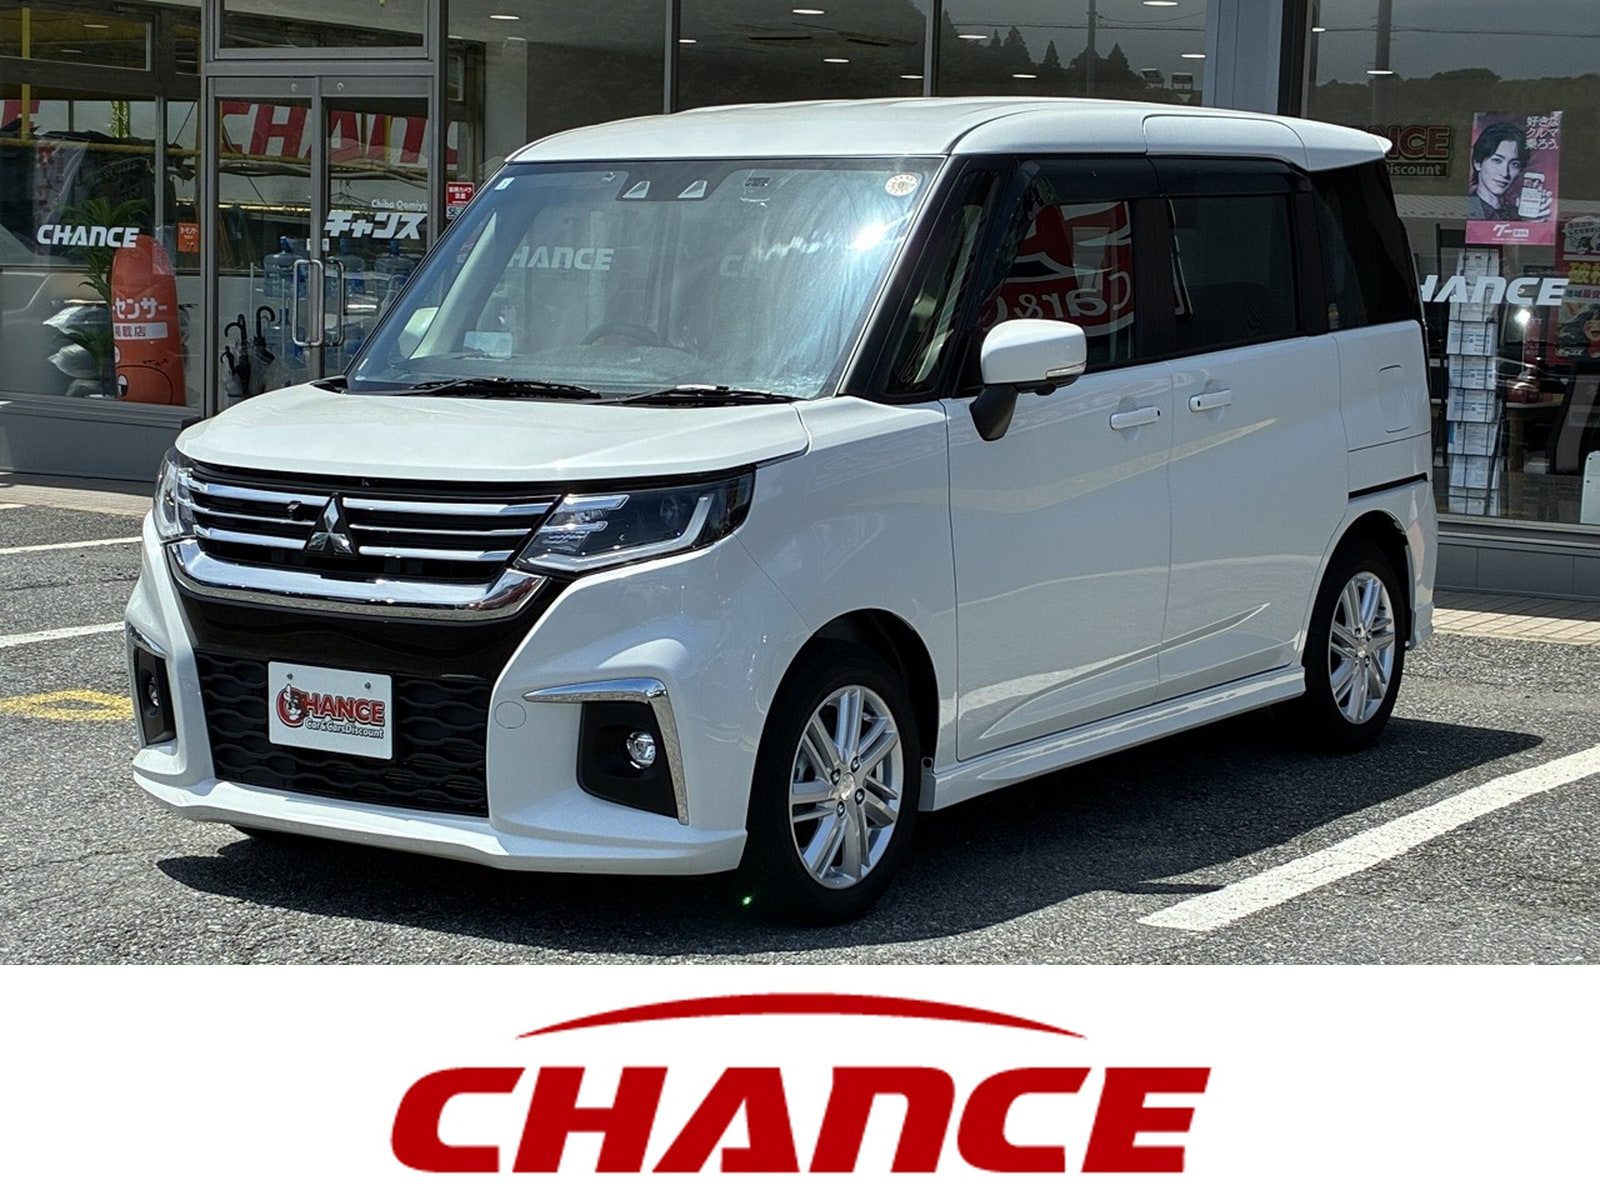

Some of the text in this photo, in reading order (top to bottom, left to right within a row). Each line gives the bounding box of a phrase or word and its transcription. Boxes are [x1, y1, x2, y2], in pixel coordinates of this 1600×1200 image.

[1525, 128, 1558, 138] クルマ
[1386, 163, 1440, 175] iscount
[37, 224, 140, 248] CHANCE
[506, 245, 615, 271] HANCE
[1420, 275, 1569, 306] HANCE
[112, 297, 167, 319] センサー
[276, 684, 386, 728] CHANCE
